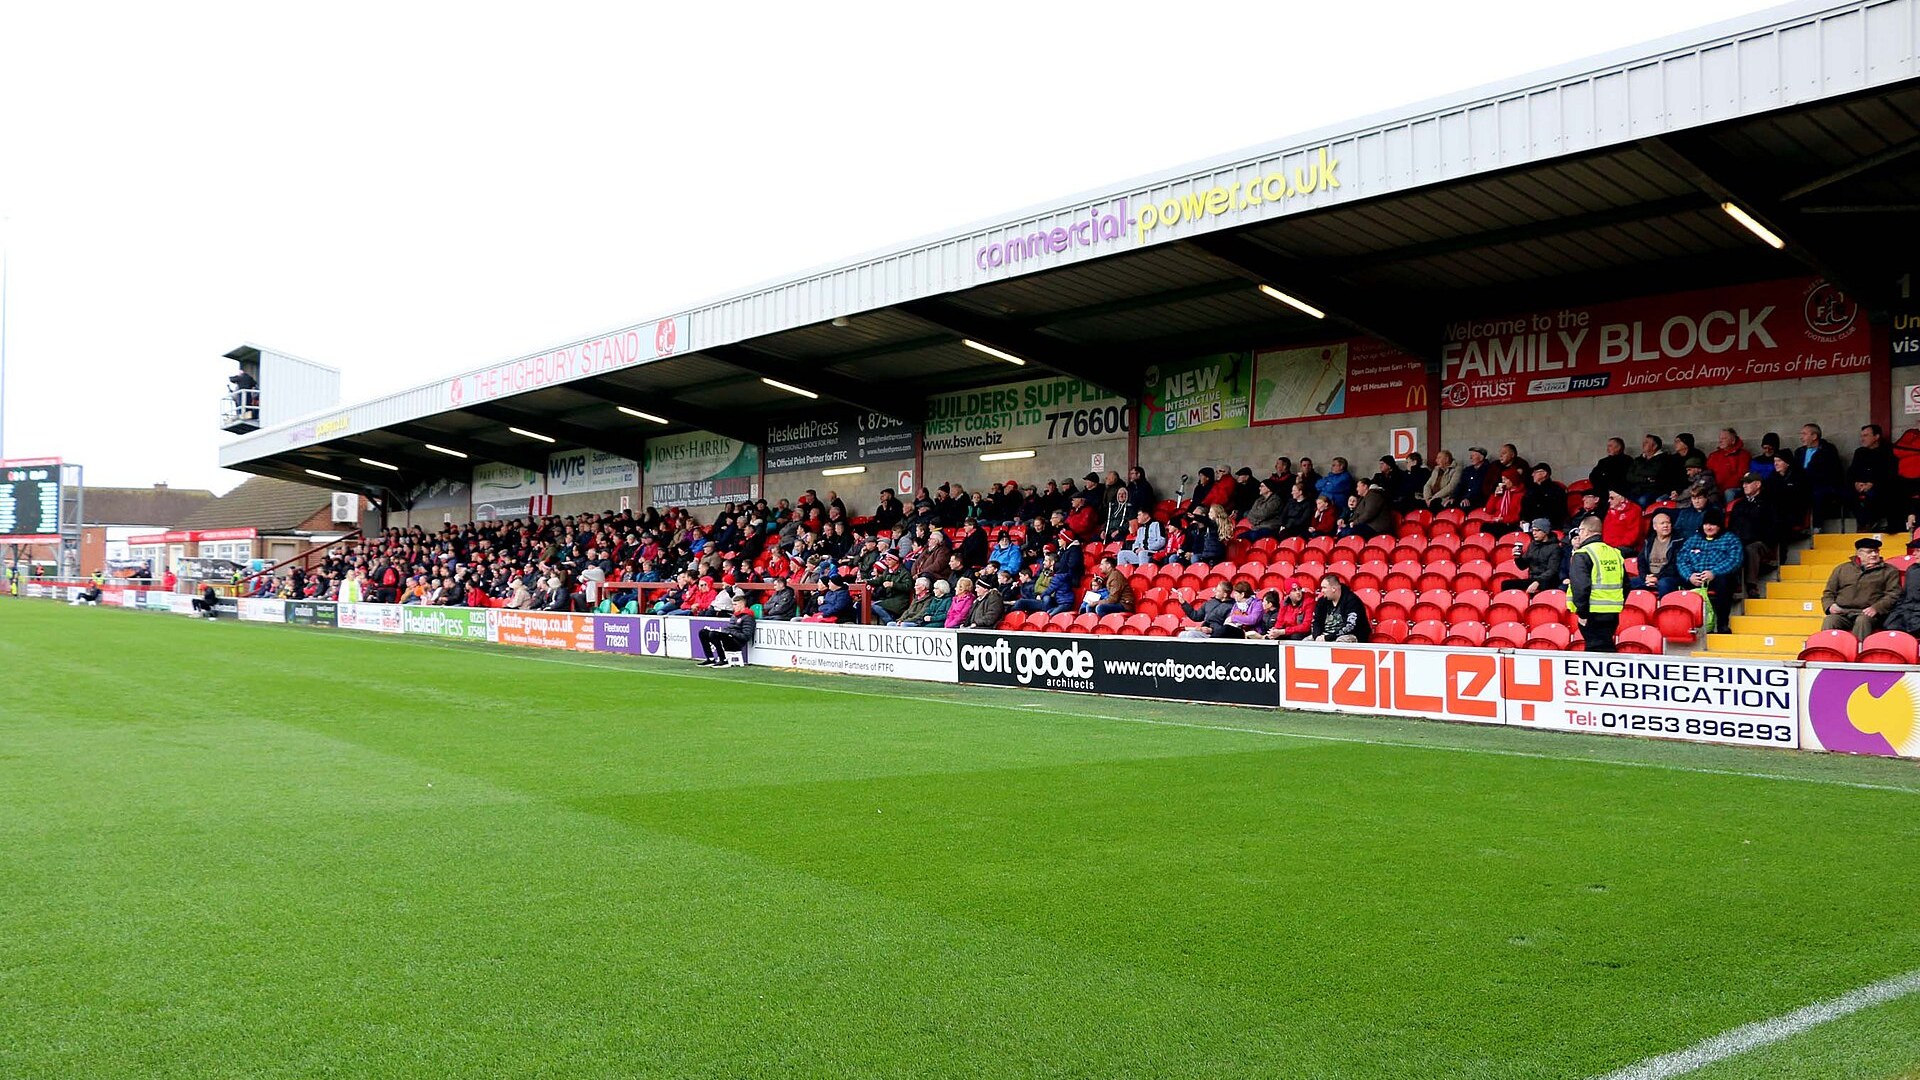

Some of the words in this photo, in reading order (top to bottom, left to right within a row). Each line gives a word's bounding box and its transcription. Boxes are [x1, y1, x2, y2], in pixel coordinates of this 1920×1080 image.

[976, 147, 1341, 271] commercial-power.co.uk
[1443, 319, 1526, 342] Welcome
[1532, 313, 1552, 332] to
[1557, 309, 1590, 329] the
[1441, 327, 1590, 381] FAMILY
[1598, 305, 1778, 366] BLOCK
[473, 370, 498, 401] THE
[501, 349, 577, 395] HIGHBURY
[581, 331, 639, 374] STAND
[1621, 369, 1662, 387] Junior
[1664, 363, 1695, 383] Cod
[1695, 363, 1734, 382] Army
[1744, 358, 1780, 374] Fans
[1784, 353, 1803, 371] of
[1804, 352, 1828, 371] the
[1165, 364, 1221, 400] NEW
[1350, 384, 1362, 392] Only
[1472, 382, 1517, 399] TRUST
[1572, 376, 1608, 389] TRUST
[926, 387, 1019, 420] BUILDERS
[1024, 380, 1117, 408] SUPPLI
[1164, 391, 1221, 412] INTERACTIVE
[965, 413, 1013, 431] COAST)
[1016, 409, 1042, 426] LTD
[1165, 402, 1221, 431] GAMES
[768, 421, 839, 444] HeskethPress
[922, 432, 1003, 451] www.bswc.biz
[1394, 430, 1414, 459] D
[550, 455, 585, 485] wyre
[768, 459, 777, 468] The
[776, 457, 793, 467] Official
[794, 455, 806, 465] Print
[806, 454, 824, 464] Partner
[825, 453, 833, 462] for
[833, 450, 848, 460] FTFC
[653, 484, 676, 501] WATCH
[679, 483, 691, 499] THE
[694, 480, 713, 497] GAME
[900, 471, 911, 493] C
[404, 609, 463, 637] HeskethPress
[498, 610, 574, 636] Astute-group.co.uk
[604, 622, 630, 634] Fleetwood
[606, 633, 629, 648] 778231
[766, 628, 803, 648] BYRNE
[807, 629, 865, 652] FUNERAL
[869, 633, 953, 658] DIRECTORS
[798, 655, 817, 666] Official
[818, 657, 844, 668] Memorial
[844, 659, 870, 670] Partners
[870, 661, 877, 671] of
[877, 662, 894, 673] FTFC
[960, 637, 1012, 674] croft
[1015, 640, 1095, 685] goode
[1104, 658, 1277, 684] www.croftgoode.co.uk
[1565, 659, 1790, 687] ENGINEERING
[1046, 676, 1095, 690] architects
[1564, 680, 1581, 696] &
[1585, 681, 1790, 710] FABRICATION
[1565, 709, 1597, 726] Tel:
[1601, 713, 1680, 732] 01253
[1686, 719, 1791, 742] 896293
